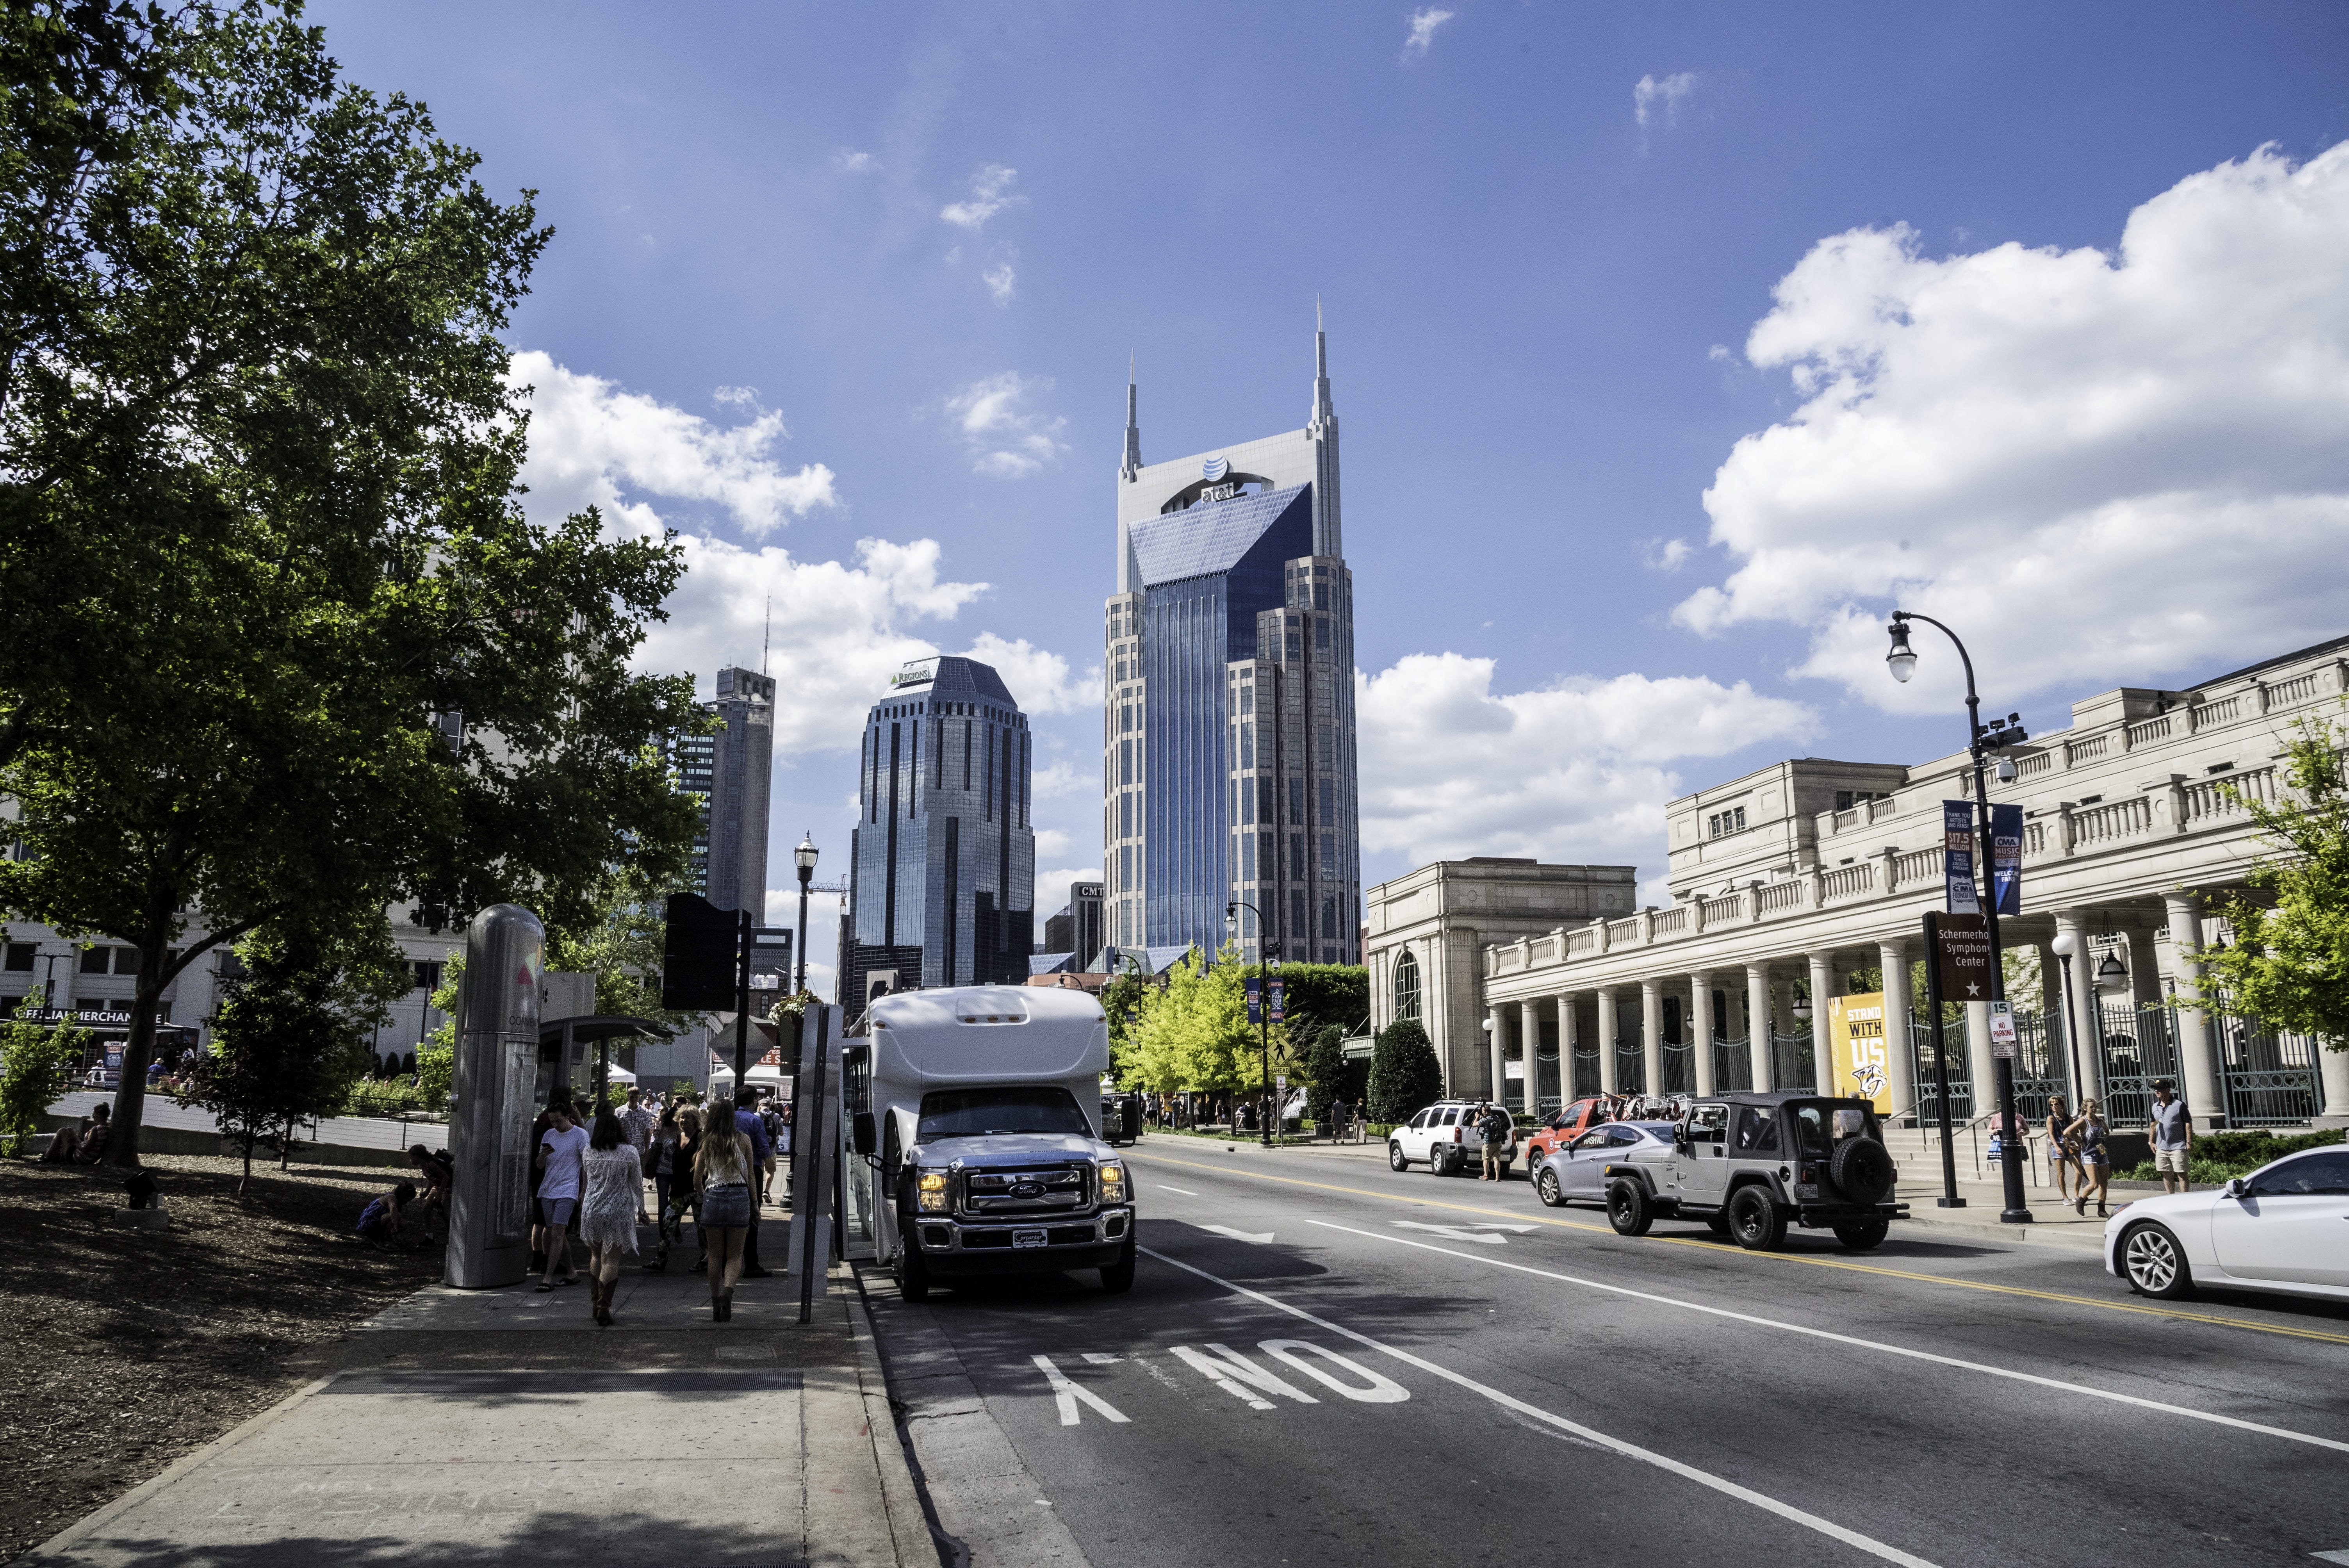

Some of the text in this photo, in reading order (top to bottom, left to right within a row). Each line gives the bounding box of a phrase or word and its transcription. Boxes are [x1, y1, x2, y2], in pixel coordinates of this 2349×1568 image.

[1203, 484, 1233, 502] at&t
[898, 670, 927, 682] REGIONS
[1948, 832, 1969, 843] $17.5
[1082, 887, 1103, 896] CMT
[1939, 929, 1989, 939] Schermerho
[1956, 957, 1985, 966] Center
[1847, 1006, 1881, 1021] STAND
[1994, 1003, 2007, 1013] 15
[73, 1011, 162, 1023] MERCHANE
[1849, 1021, 1882, 1037] WITH
[1993, 1029, 2013, 1037] PARKING
[1850, 1038, 1885, 1068] US
[1018, 1185, 1037, 1194] Ford
